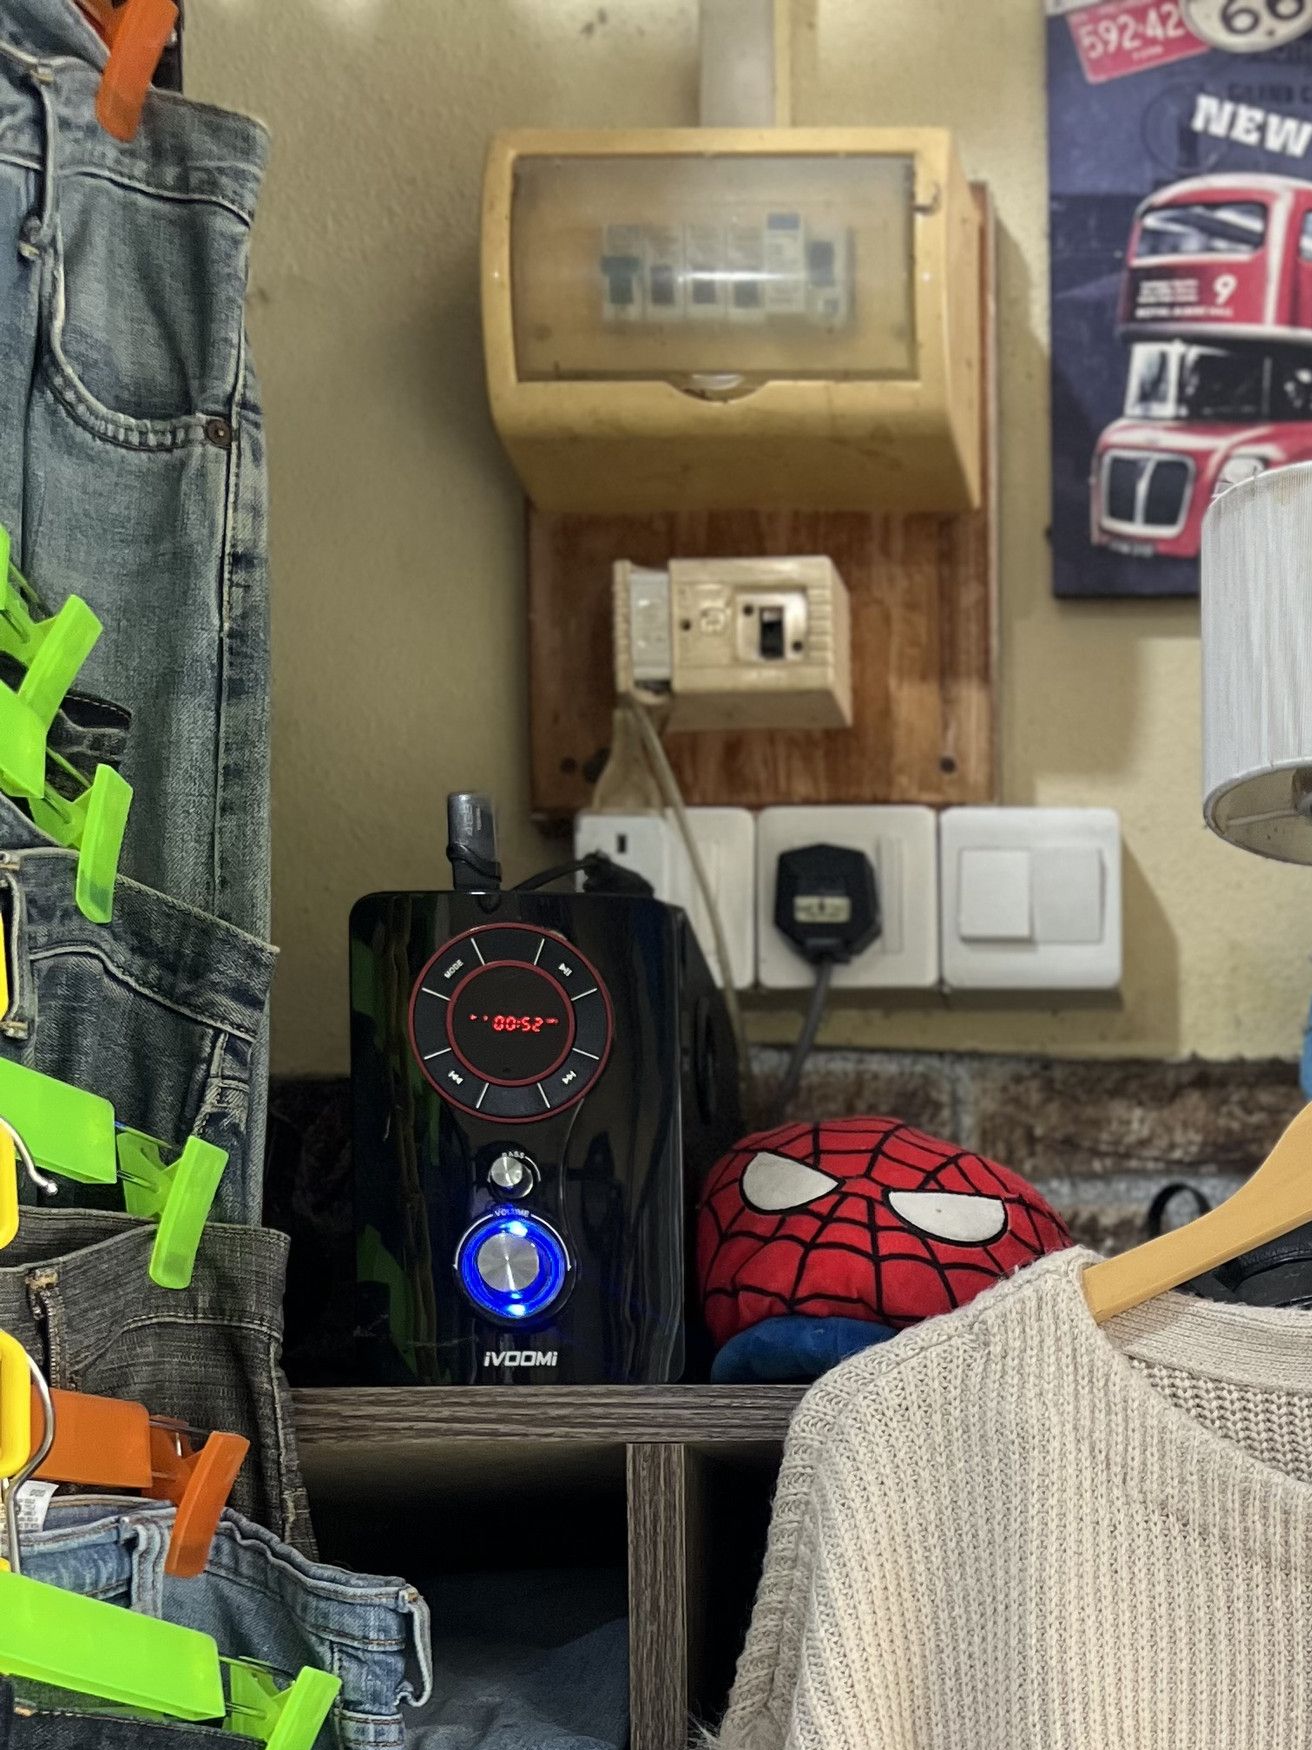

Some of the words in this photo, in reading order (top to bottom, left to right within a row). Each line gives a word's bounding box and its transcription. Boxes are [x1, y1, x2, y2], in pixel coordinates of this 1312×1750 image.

[1213, 274, 1238, 305] 9
[443, 958, 465, 979] MODE
[492, 1014, 544, 1033] 00:52
[494, 1208, 531, 1219] VOLUME
